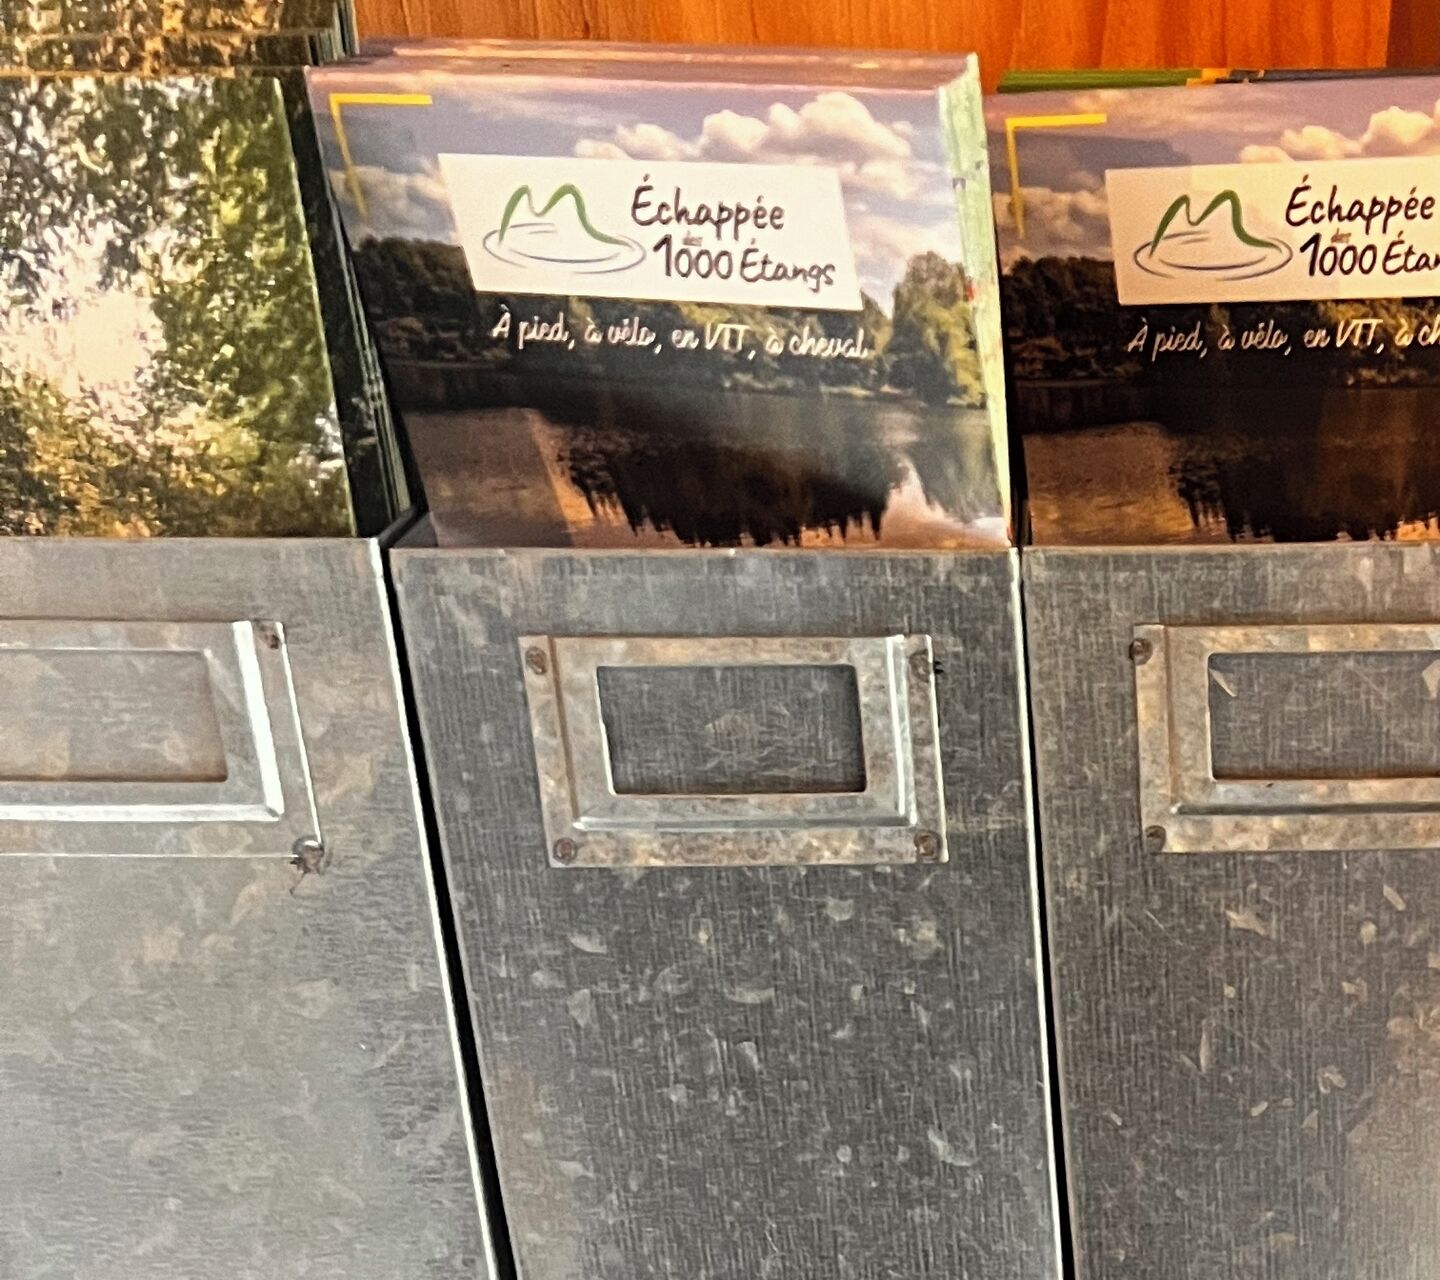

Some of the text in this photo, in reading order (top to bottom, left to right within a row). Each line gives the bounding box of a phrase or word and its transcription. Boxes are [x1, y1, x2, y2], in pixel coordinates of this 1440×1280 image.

[631, 175, 785, 241] Échappée
[1285, 175, 1436, 234] Échappée
[653, 234, 835, 290] 1000 Étangs
[1299, 232, 1377, 277] 1000
[492, 304, 510, 338] À
[517, 312, 574, 350] pied,
[583, 318, 601, 348] à
[607, 317, 661, 355] vélo,
[671, 328, 699, 350] en
[705, 322, 754, 359] VTT,
[765, 328, 784, 353] à
